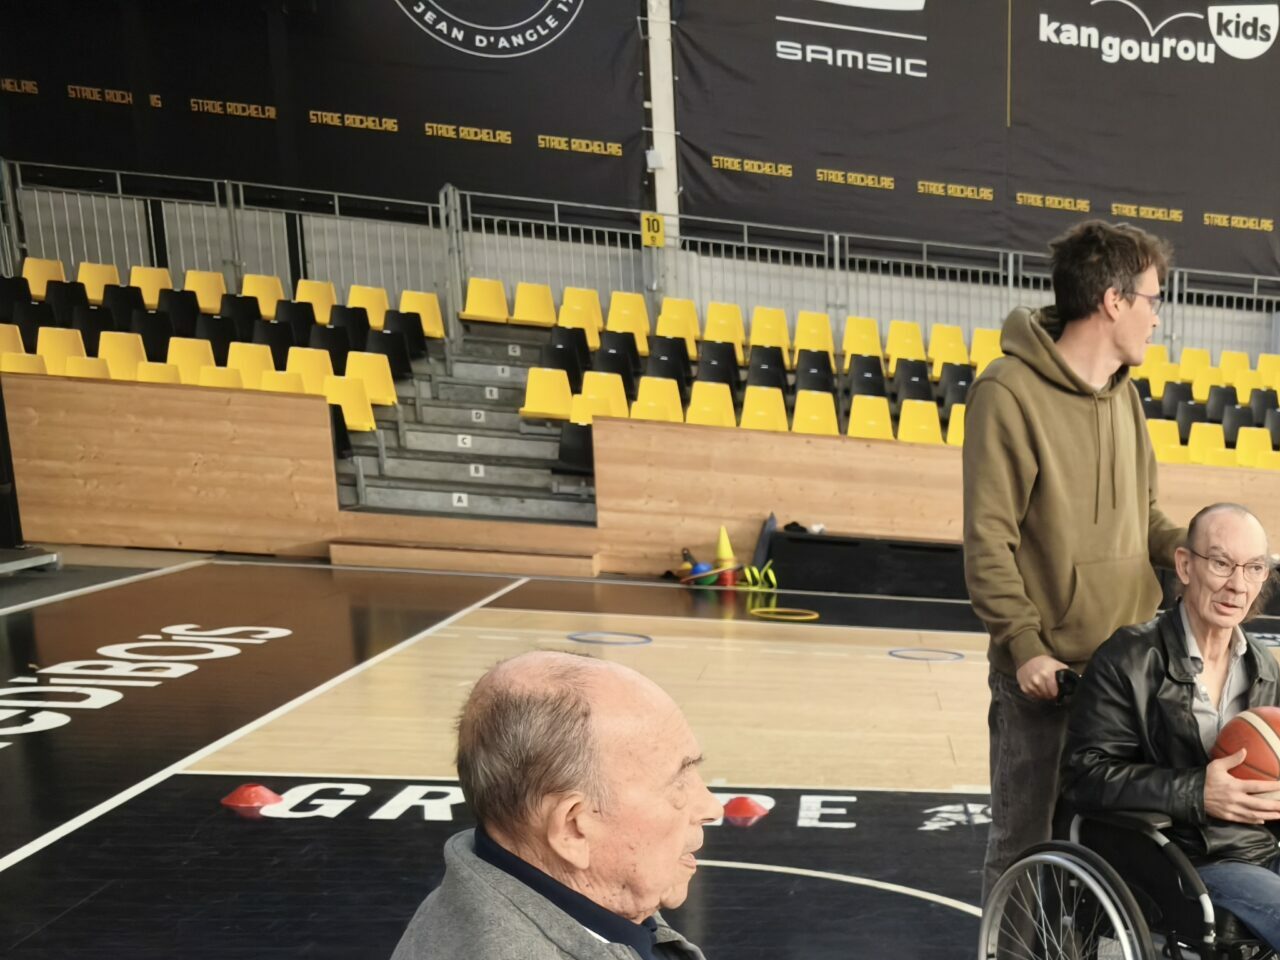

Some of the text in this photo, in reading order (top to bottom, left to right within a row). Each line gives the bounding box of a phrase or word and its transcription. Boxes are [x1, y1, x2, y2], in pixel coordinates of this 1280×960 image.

[413, 2, 464, 41] JEAN
[475, 15, 559, 48] D'ANGLE
[1039, 11, 1272, 63] kangourou kids
[776, 41, 927, 77] SAMSIC
[69, 86, 101, 101] STADE
[192, 99, 224, 115] STADE
[310, 112, 399, 132] STADE ROCHELAIS
[426, 123, 512, 144] STADE ROCHELAIS
[538, 136, 623, 157] STADE ROCHELAIS
[712, 156, 792, 177] STADE ROCHELAIS
[816, 169, 895, 190] STADE ROCHELAIS
[918, 181, 993, 201] STADE ROCHELAIS
[1017, 193, 1090, 212] STADE ROCHELAIS
[1112, 204, 1183, 222] STADE ROCHELAIS
[1204, 213, 1274, 232] STADE ROCHELAIS
[645, 217, 660, 233] 10
